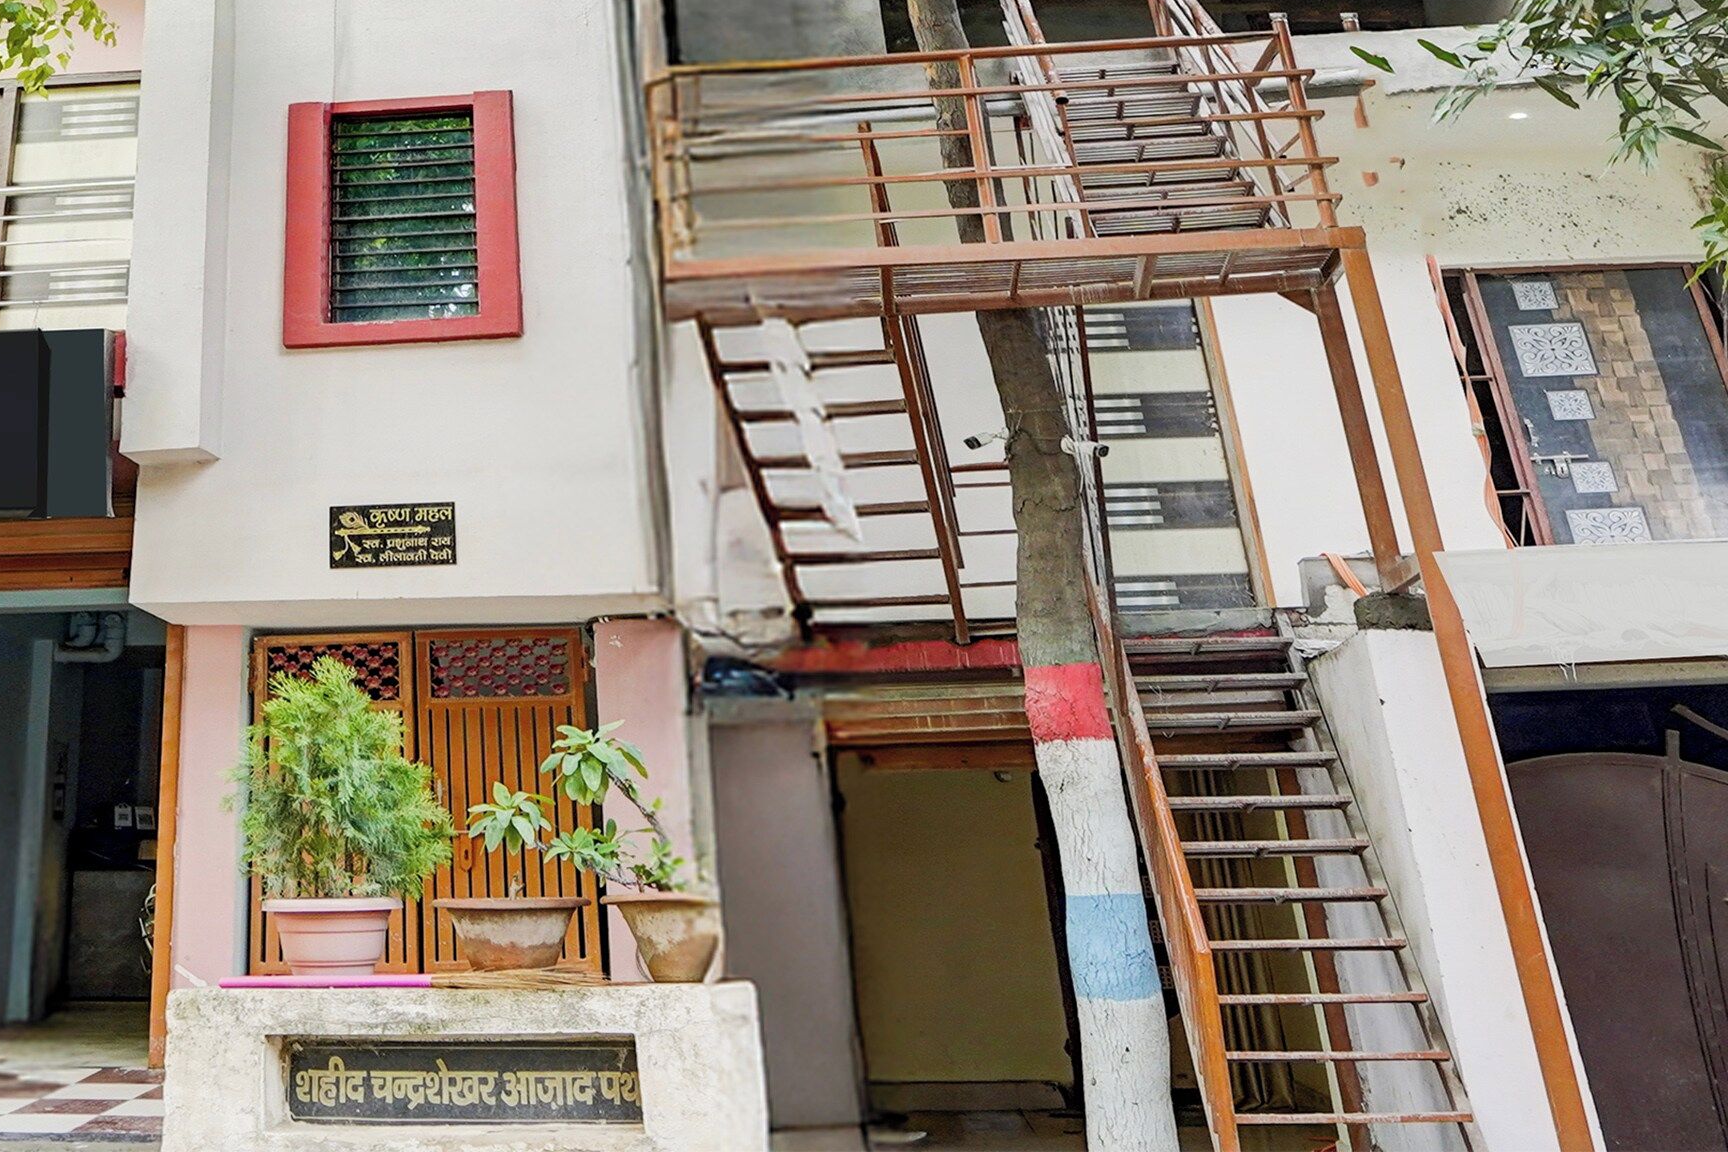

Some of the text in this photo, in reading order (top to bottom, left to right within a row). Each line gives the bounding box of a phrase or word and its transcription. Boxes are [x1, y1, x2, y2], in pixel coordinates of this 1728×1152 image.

[369, 506, 452, 528] कृष्ण महल
[379, 549, 427, 562] लीलावती
[296, 1055, 366, 1107] शहीद
[370, 1058, 499, 1110] चन्द्रशेखर
